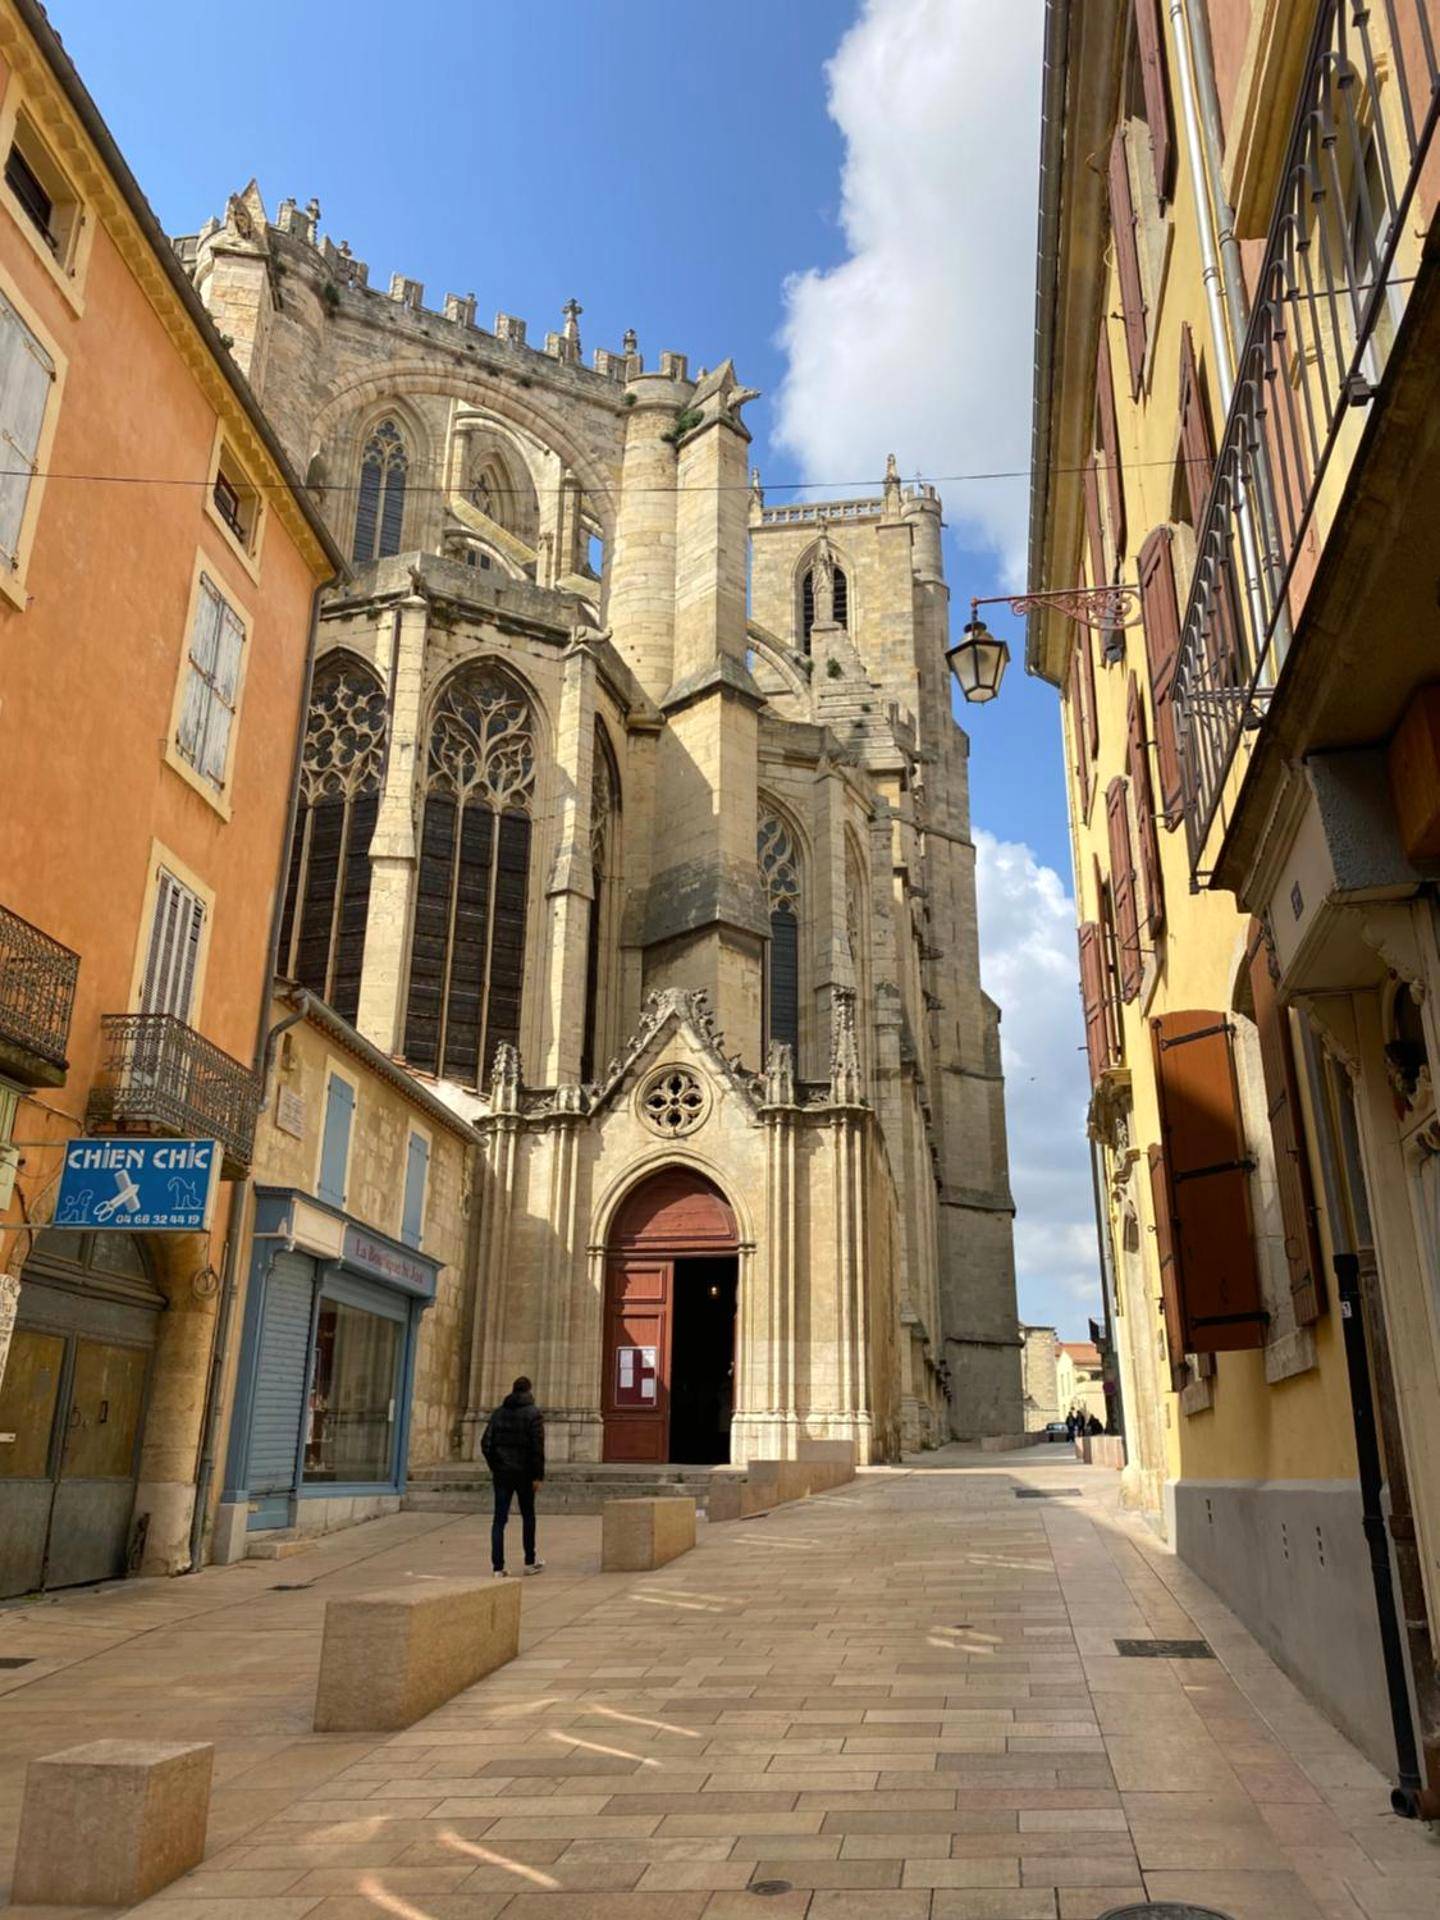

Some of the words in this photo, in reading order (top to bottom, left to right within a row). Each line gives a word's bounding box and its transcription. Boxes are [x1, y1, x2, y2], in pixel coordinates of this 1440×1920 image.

[115, 1214, 131, 1225] 04
[134, 1214, 150, 1225] 68
[152, 1214, 167, 1225] 32
[169, 1214, 185, 1225] 44
[187, 1214, 200, 1225] 19
